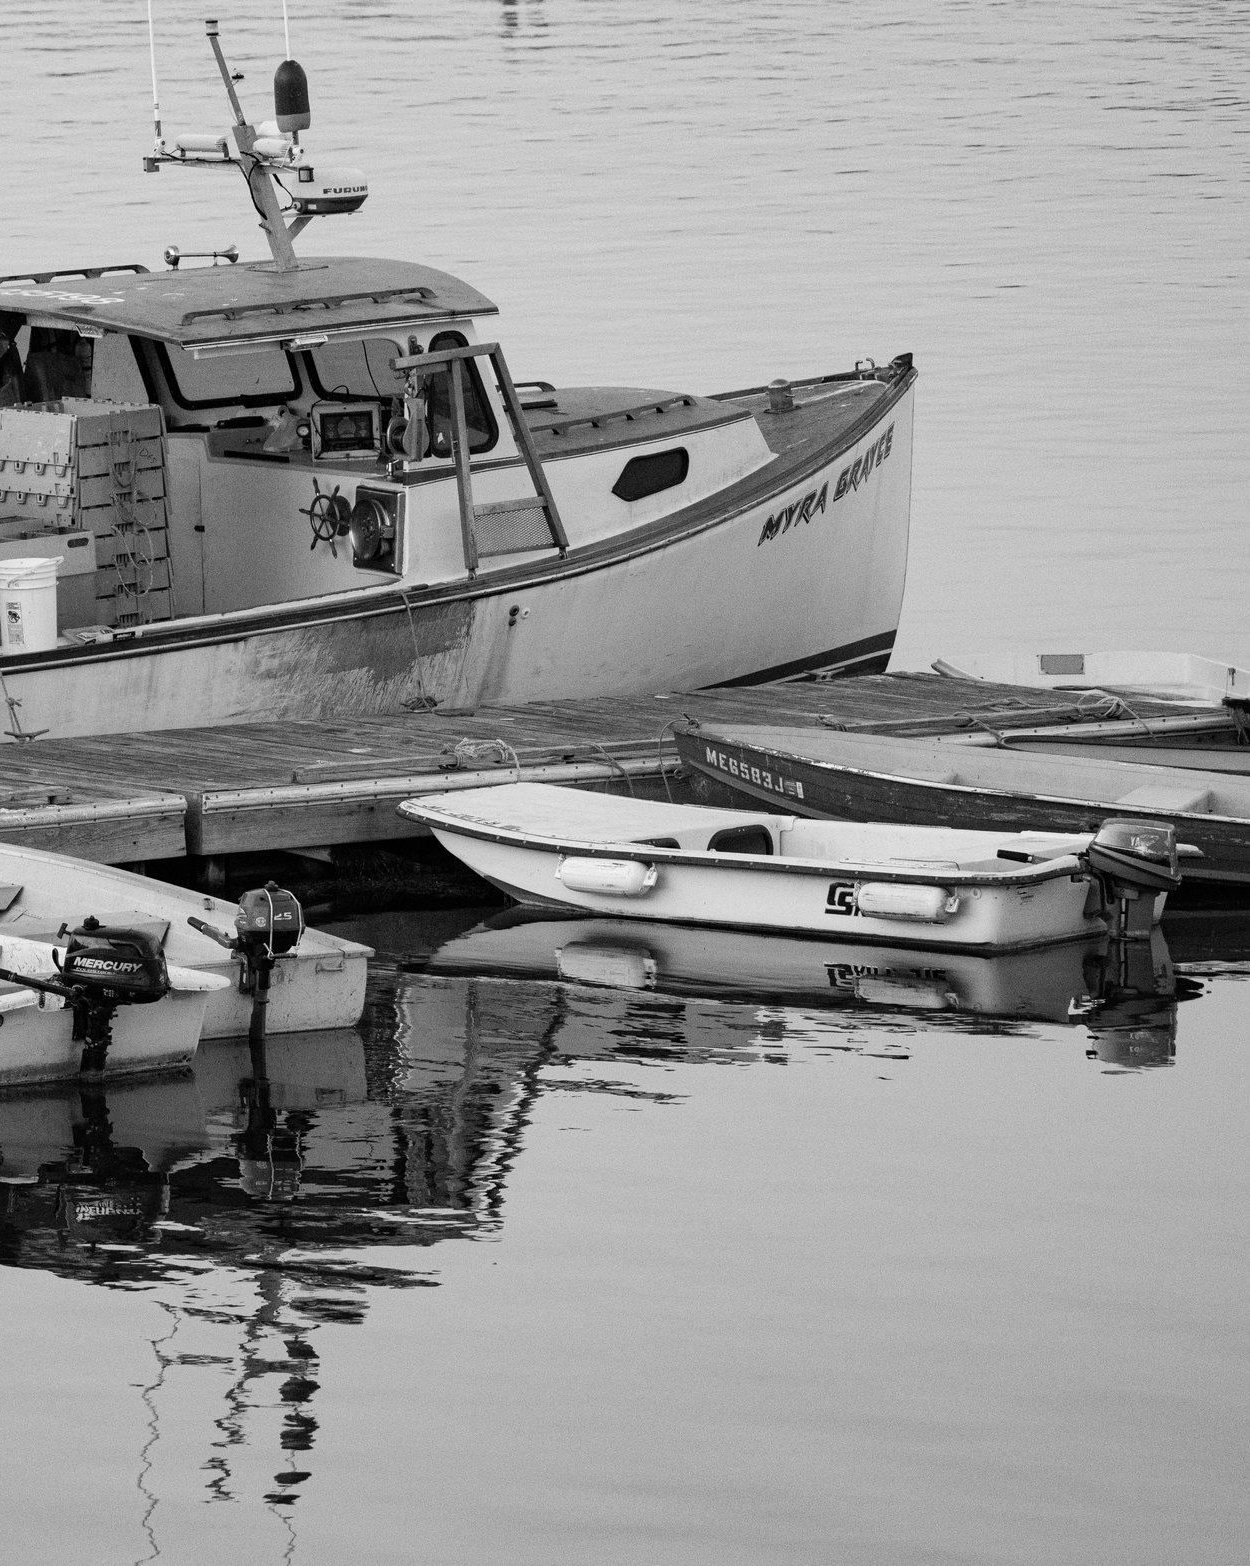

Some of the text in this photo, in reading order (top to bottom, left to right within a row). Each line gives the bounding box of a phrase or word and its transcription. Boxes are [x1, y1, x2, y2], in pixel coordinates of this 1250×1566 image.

[757, 421, 895, 547] MYRA GRAYCE
[73, 956, 142, 973] MERCURY
